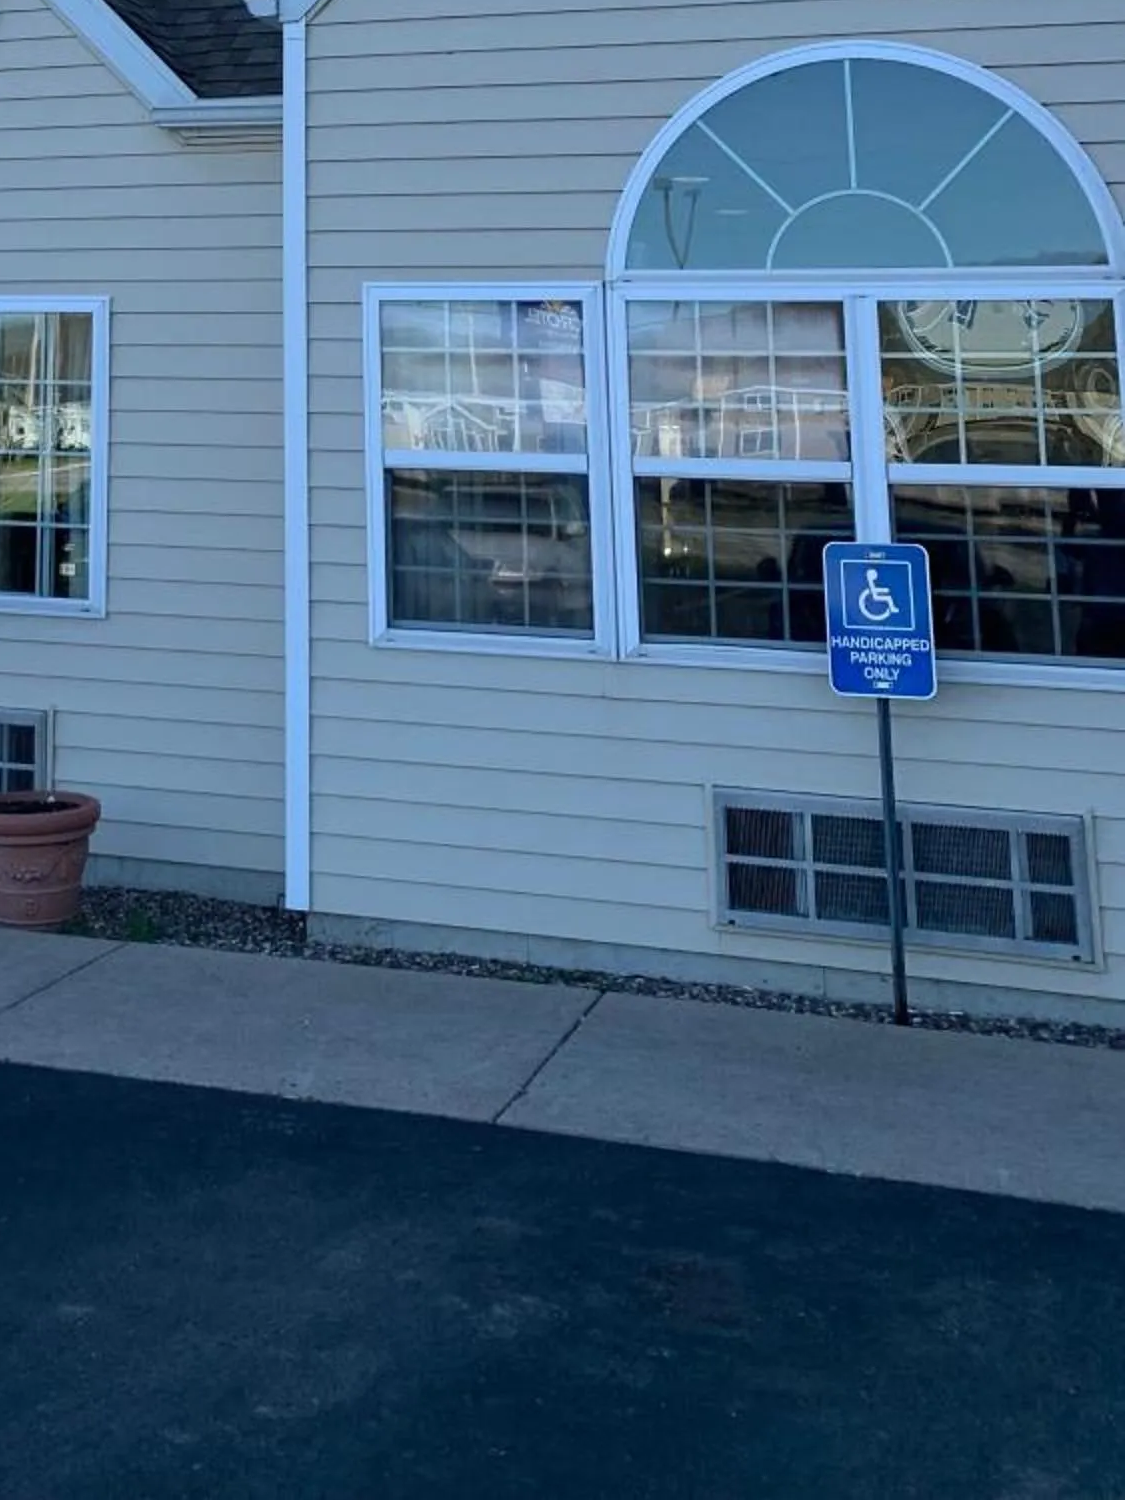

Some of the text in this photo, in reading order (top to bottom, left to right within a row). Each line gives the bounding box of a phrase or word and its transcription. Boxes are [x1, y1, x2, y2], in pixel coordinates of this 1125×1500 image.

[831, 635, 930, 652] HANDICAPPED
[850, 651, 912, 666] PARKING
[864, 667, 900, 681] ONLY
